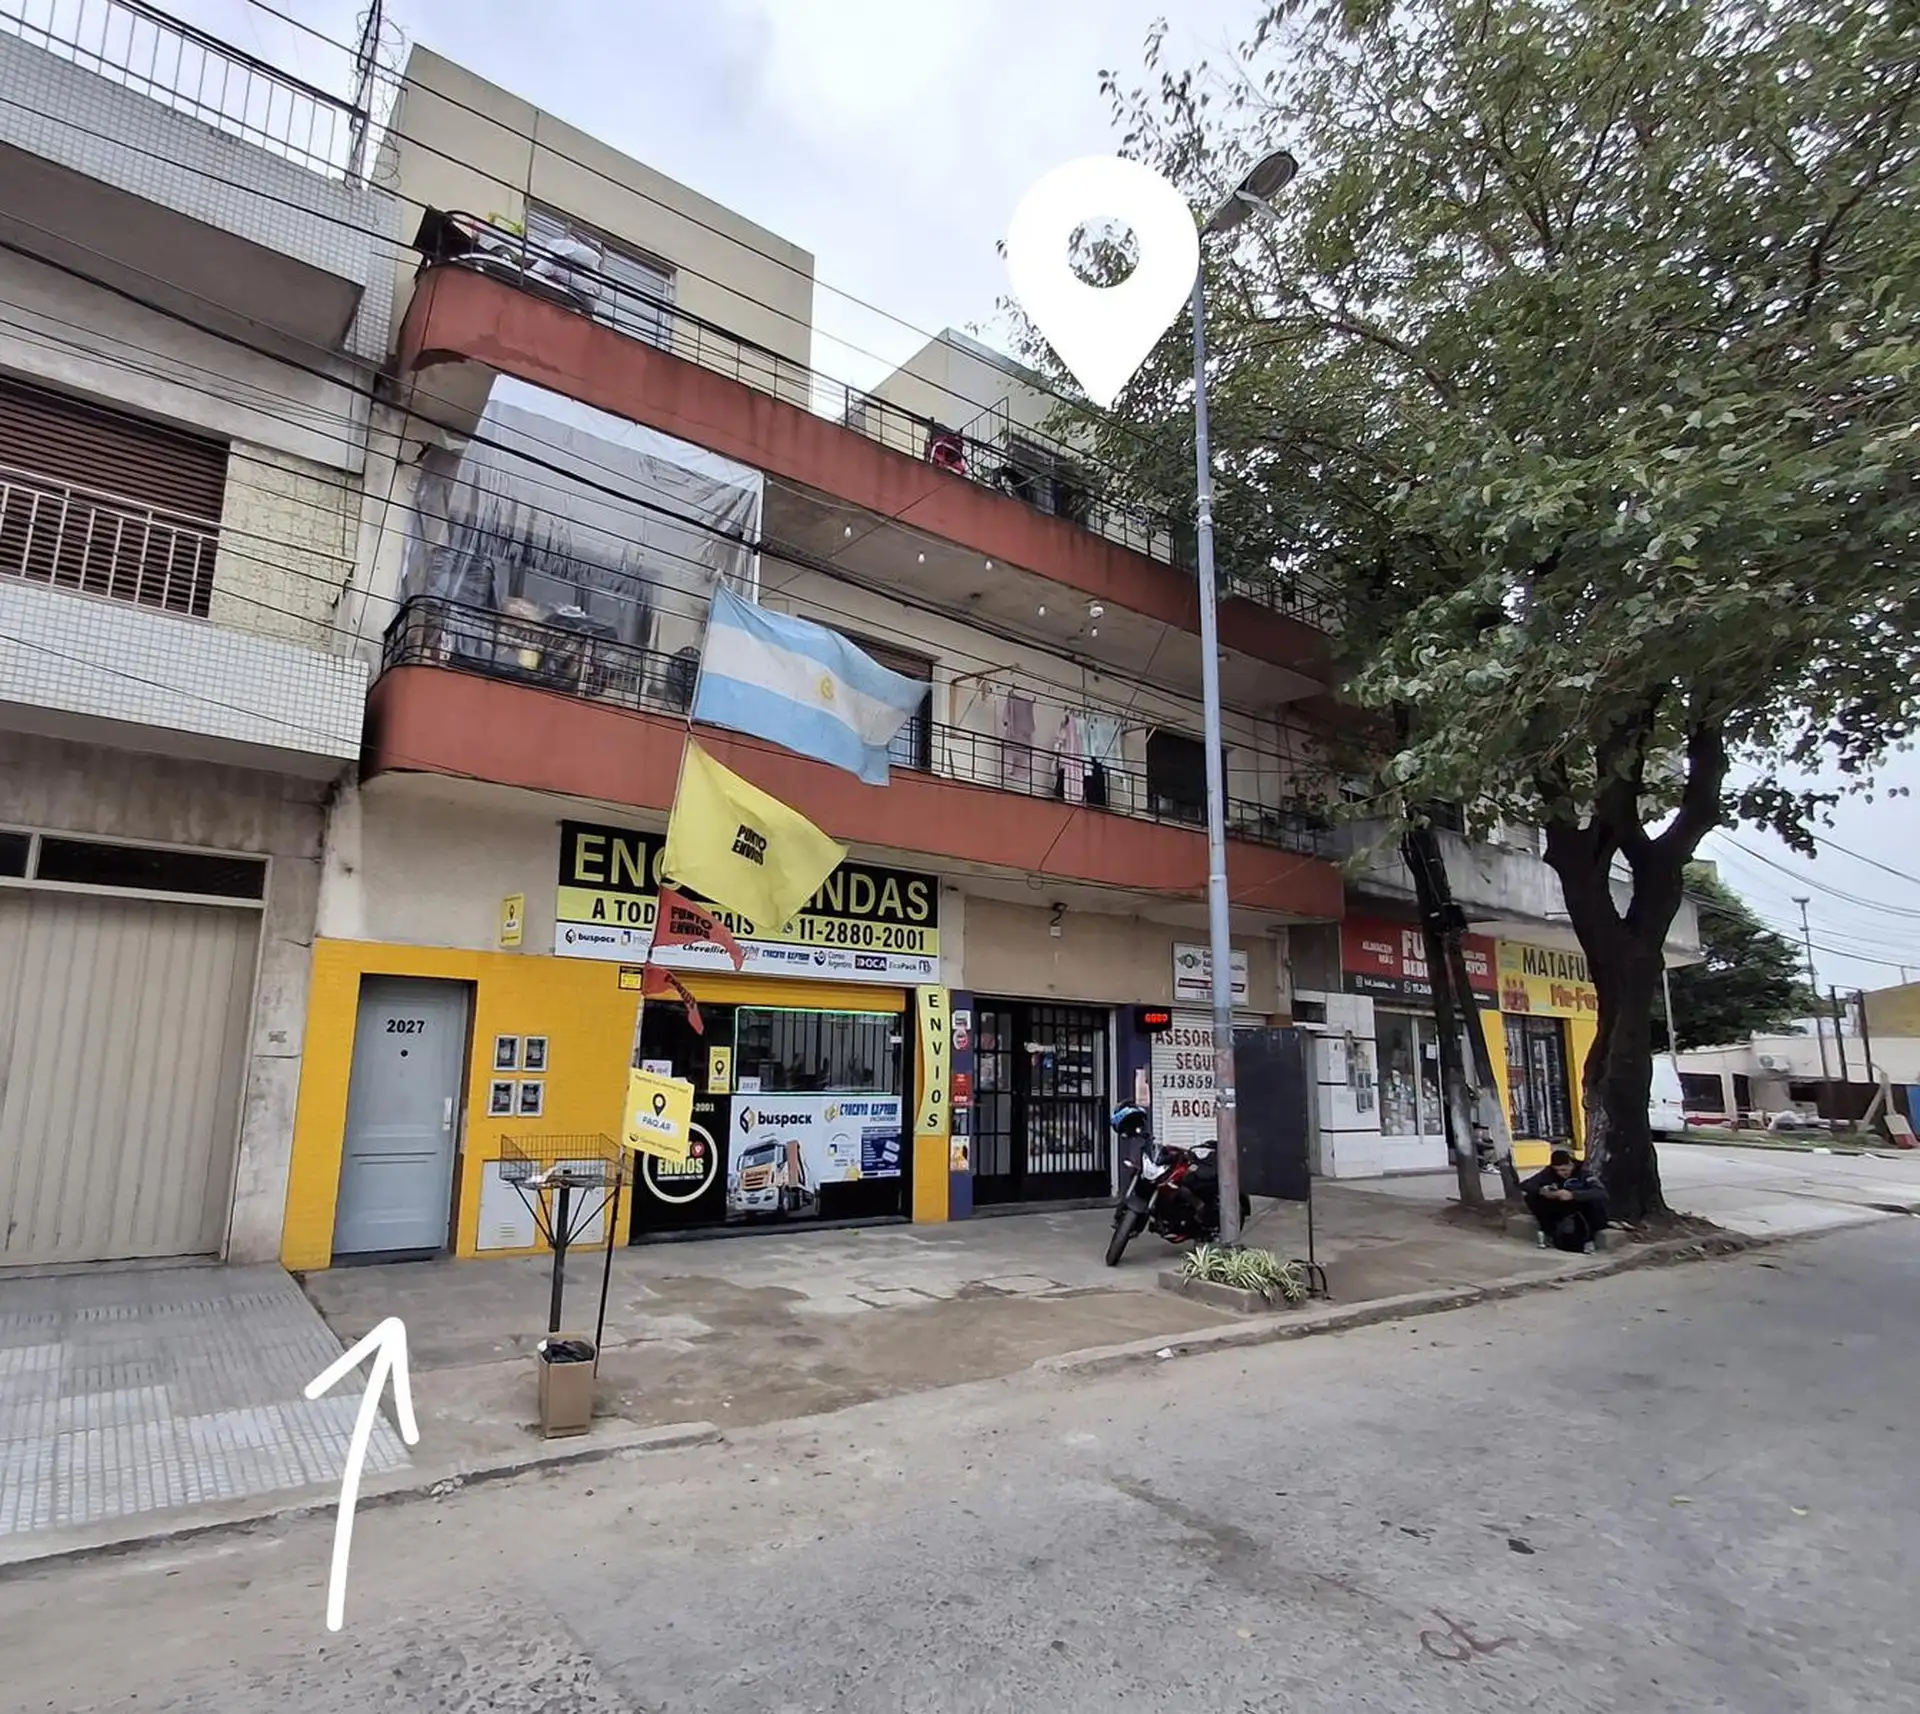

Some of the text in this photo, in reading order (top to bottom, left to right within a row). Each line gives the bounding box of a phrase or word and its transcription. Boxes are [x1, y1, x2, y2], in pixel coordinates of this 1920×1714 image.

[736, 824, 767, 851] PUNTO
[731, 839, 764, 866] ENVIOS
[592, 897, 606, 920] A
[614, 899, 657, 924] TOD
[800, 917, 925, 950] 11-2880-2001
[670, 906, 713, 930] PUNTO
[1523, 947, 1592, 982] MATAFU
[386, 1019, 425, 1034] 2027
[1155, 1029, 1214, 1047] ASESOR
[926, 993, 942, 1128] ENVIOS
[1176, 1052, 1215, 1071] SEGU
[1162, 1074, 1214, 1088] 113859
[758, 1111, 812, 1127] buspack
[657, 1157, 704, 1176] ENVIOS
